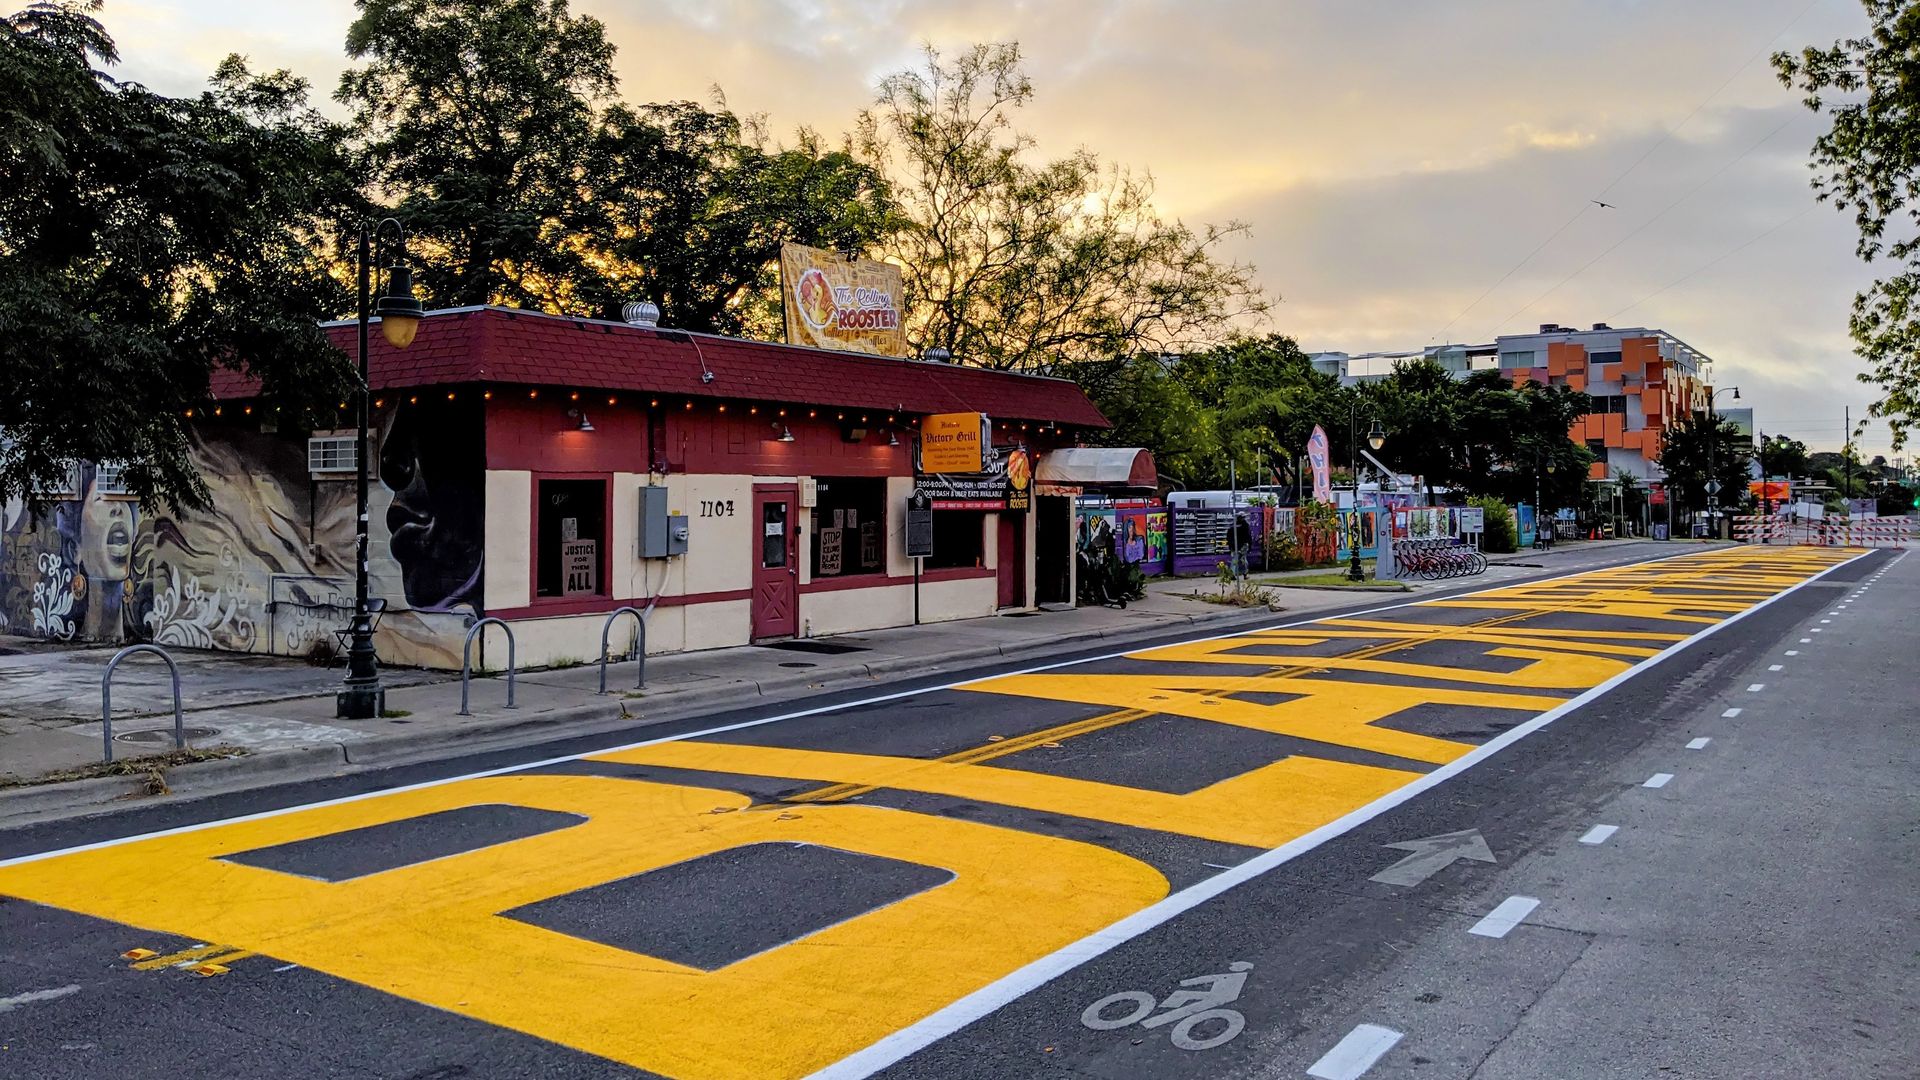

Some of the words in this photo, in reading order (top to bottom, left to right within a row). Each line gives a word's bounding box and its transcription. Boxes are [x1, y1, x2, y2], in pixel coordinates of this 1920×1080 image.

[835, 286, 853, 306] The
[856, 286, 891, 308] Rolling
[838, 309, 898, 328] ROOSTER
[926, 432, 954, 443] Victory
[957, 431, 977, 442] Grill
[968, 490, 979, 498] EATS
[980, 490, 1003, 498] AVAILABLE
[700, 500, 735, 517] 1104
[823, 531, 841, 545] STOP
[564, 544, 594, 555] JUSTICE
[821, 553, 840, 562] BLACK
[821, 562, 840, 570] PEOPLE
[568, 572, 592, 592] ALL
[327, 592, 357, 622] FOO
